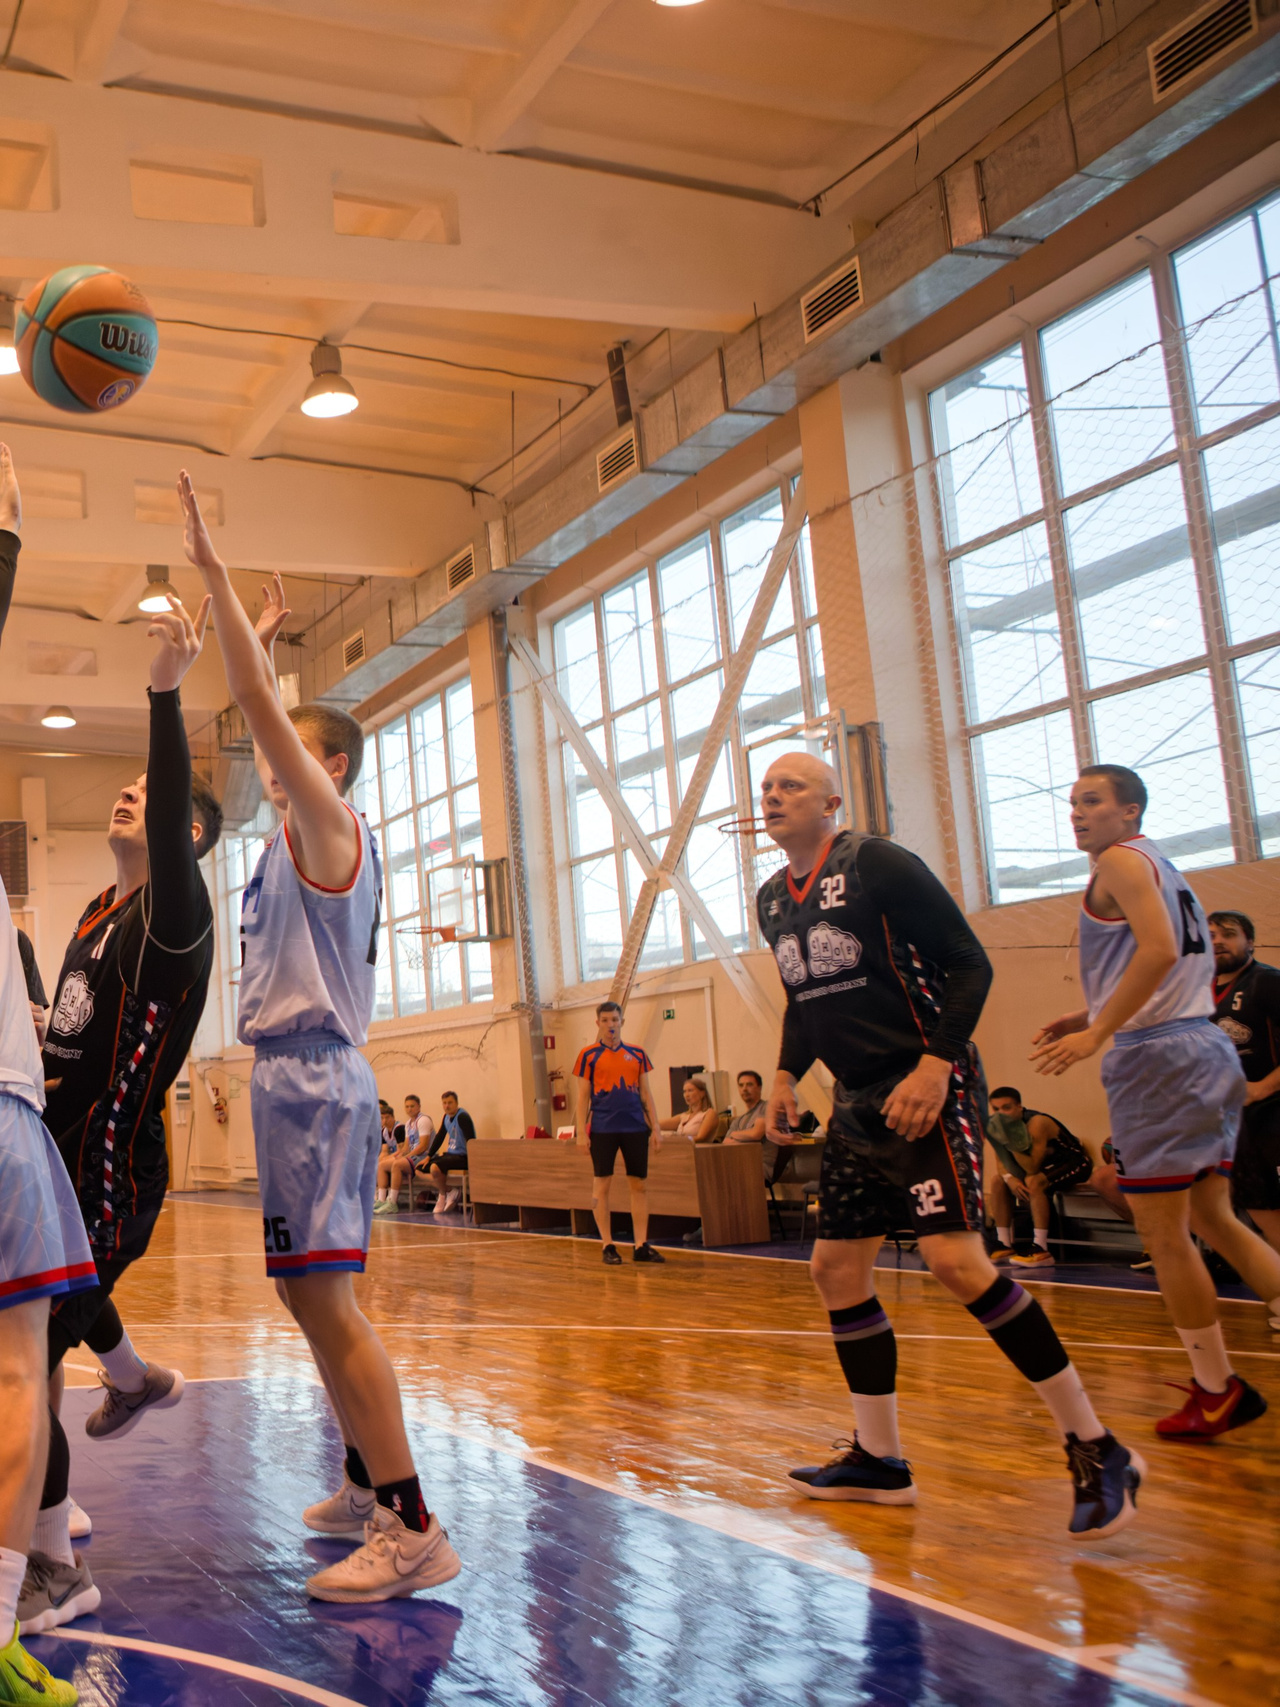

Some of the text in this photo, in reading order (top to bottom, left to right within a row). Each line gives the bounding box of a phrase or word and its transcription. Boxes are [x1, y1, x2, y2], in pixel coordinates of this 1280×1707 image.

[820, 873, 847, 910] 32
[1231, 991, 1244, 1012] 5
[909, 1178, 947, 1217] 32
